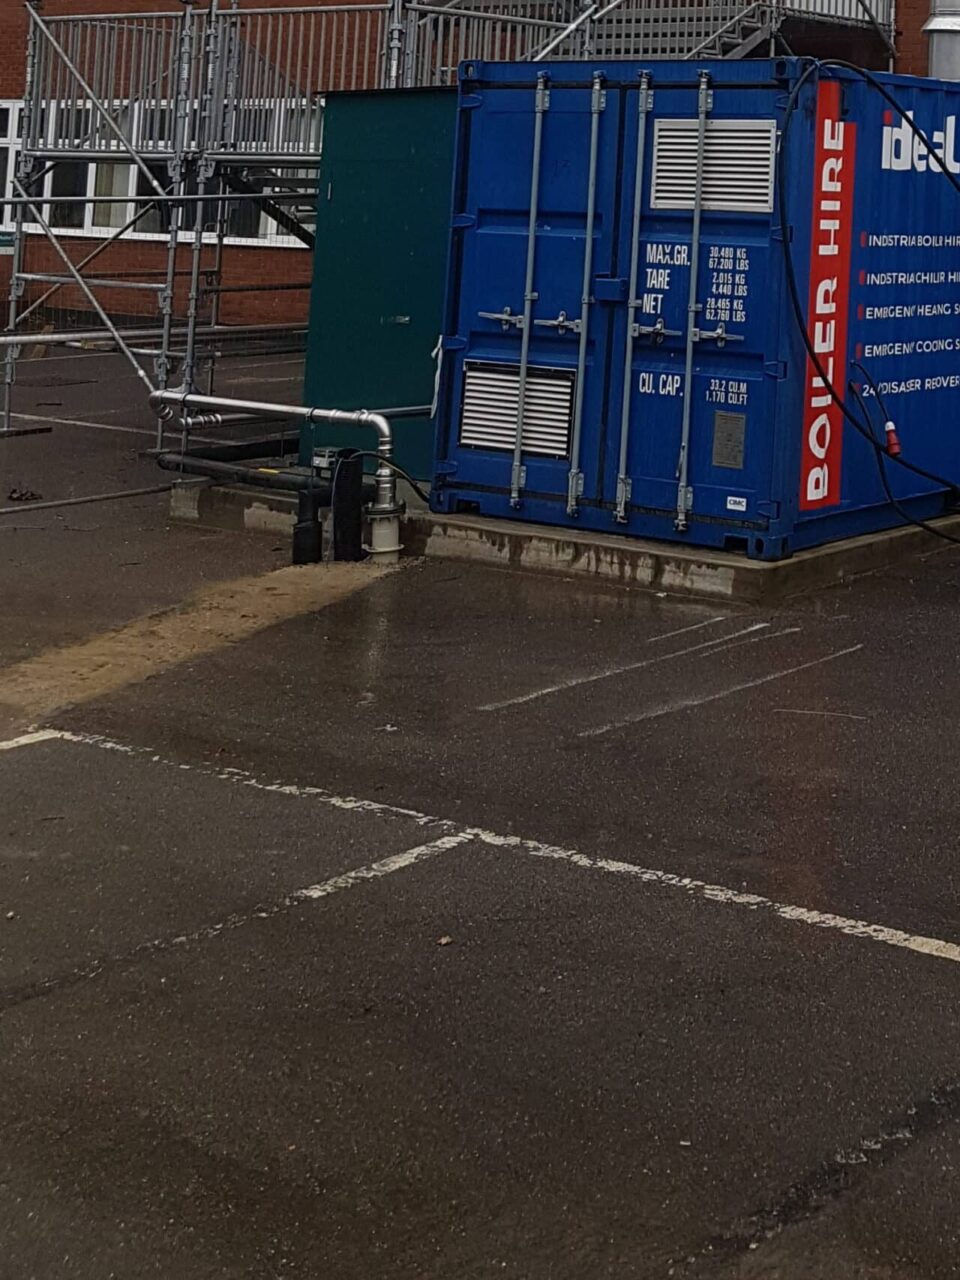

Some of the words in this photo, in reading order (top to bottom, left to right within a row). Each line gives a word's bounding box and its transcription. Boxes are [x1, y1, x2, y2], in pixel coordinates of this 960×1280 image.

[882, 110, 960, 174] ideal
[818, 118, 845, 256] HIRE
[737, 247, 747, 259] KG
[736, 259, 750, 270] LBS
[646, 268, 671, 289] TARE
[735, 274, 746, 285] KG
[734, 285, 748, 296] LBS
[642, 293, 664, 314] NET
[733, 299, 744, 310] KG
[732, 310, 746, 322] LBS
[639, 372, 655, 394] CU.
[659, 374, 684, 397] CAP.
[710, 379, 726, 392] 33.2
[728, 381, 747, 393] CU.M
[806, 276, 838, 501] BOILER
[727, 392, 748, 405] CU.FT
